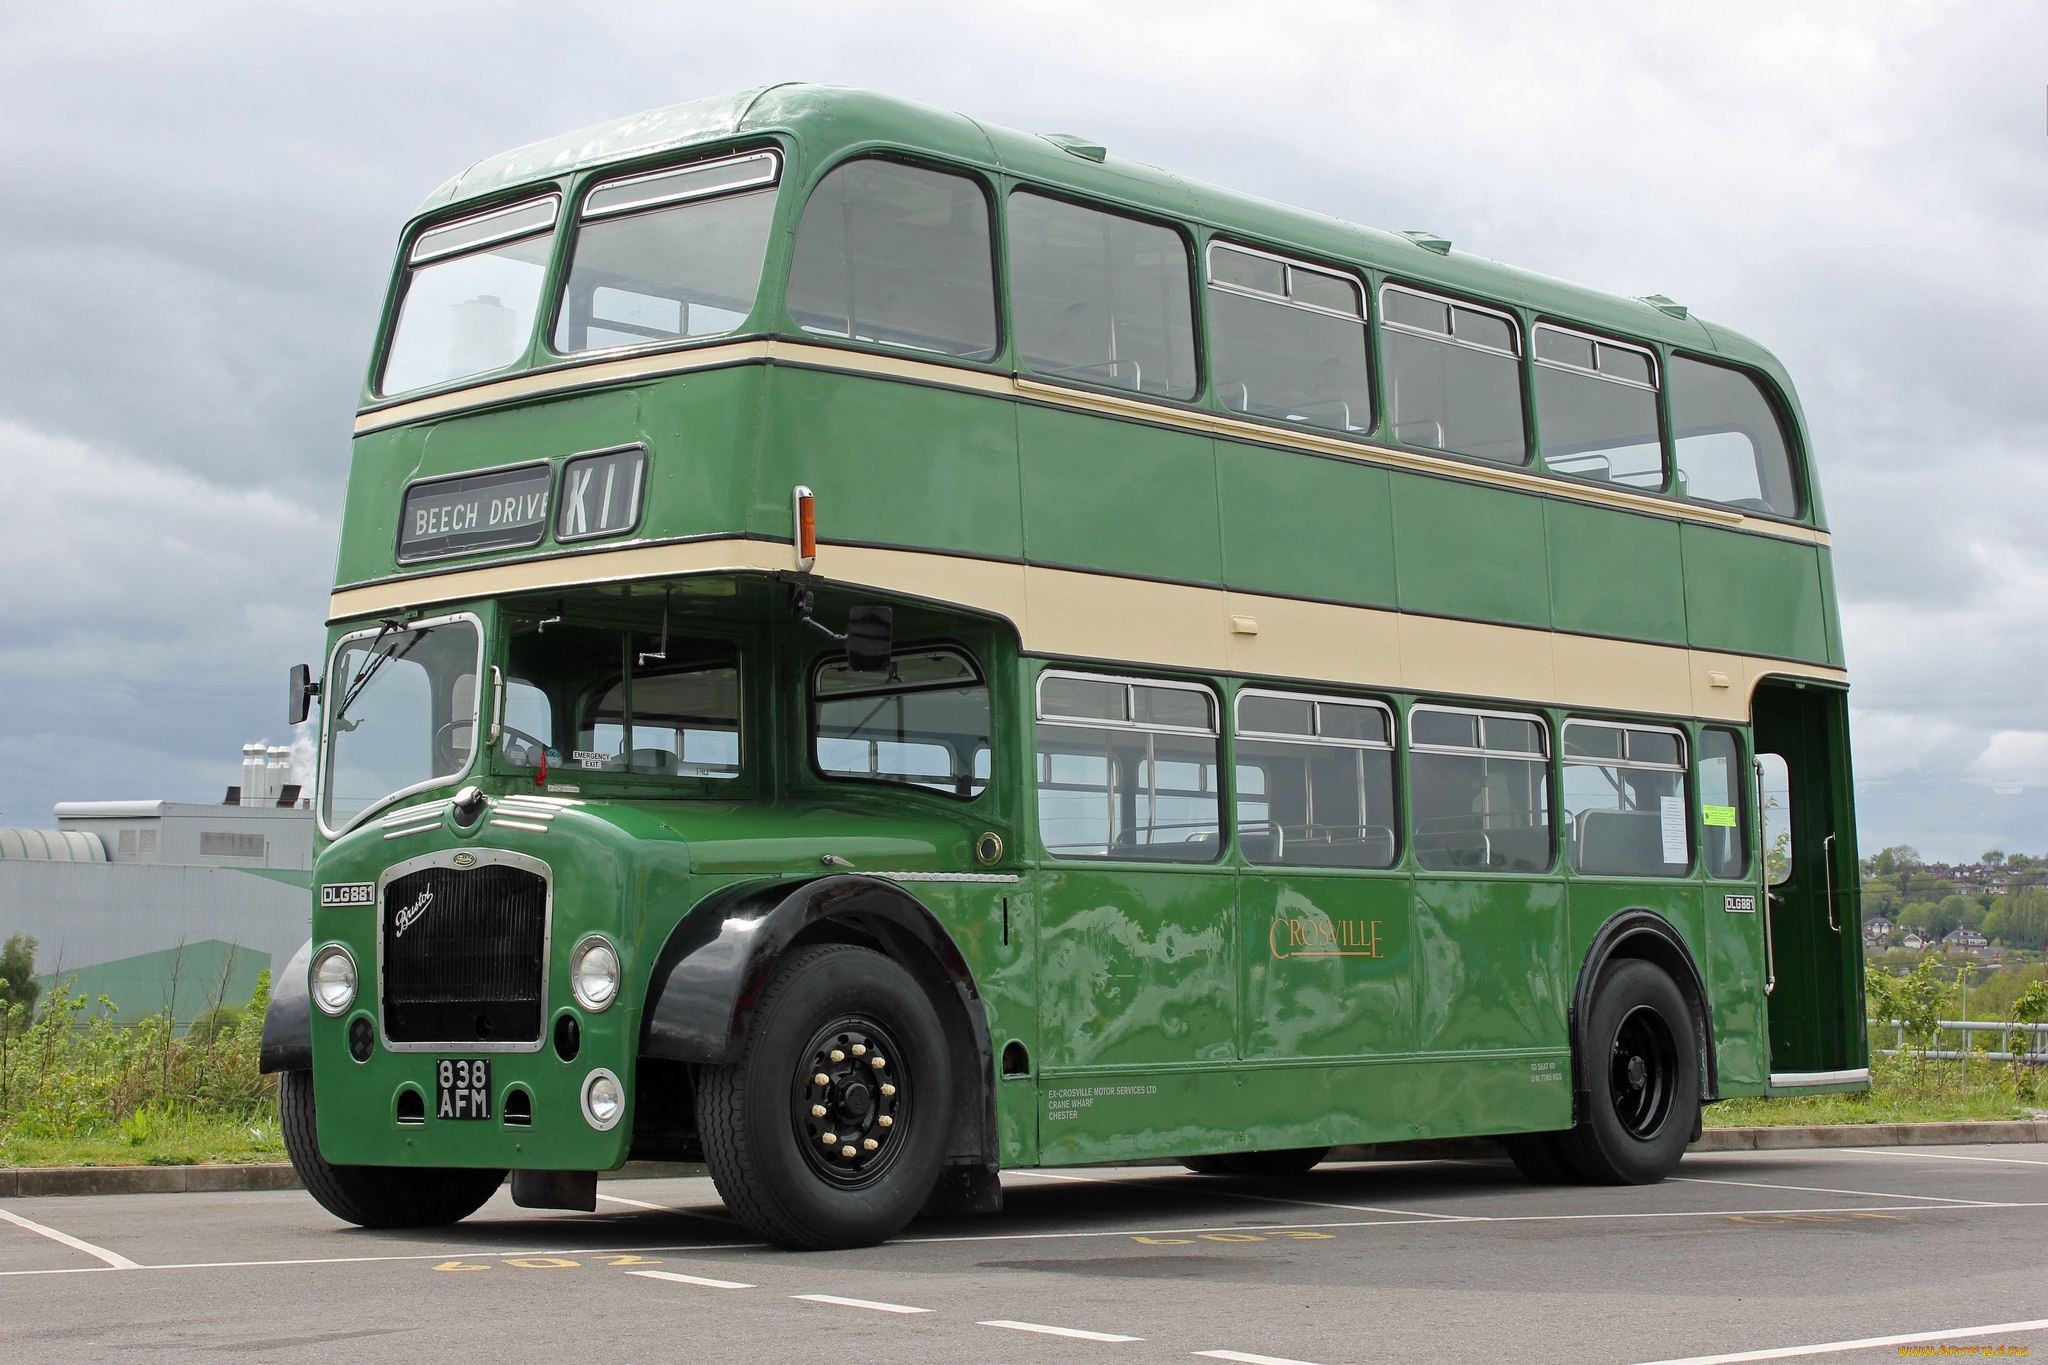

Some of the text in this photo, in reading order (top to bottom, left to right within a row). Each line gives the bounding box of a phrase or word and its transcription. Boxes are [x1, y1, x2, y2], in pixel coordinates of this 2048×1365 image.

[415, 491, 549, 536] BEECH DRIVE
[574, 751, 610, 761] EMERGENCY
[585, 760, 599, 768] EXIT
[323, 886, 373, 903] DLG881
[395, 882, 434, 938] Bristol
[1269, 918, 1384, 960] CROSVILLE
[440, 1060, 486, 1089] 838
[1048, 1085, 1157, 1098] EX-CROSVILLE MOTOR SERVICES LTD
[440, 1089, 487, 1118] AFM
[1048, 1098, 1094, 1109] CRANE WHARF
[1048, 1110, 1078, 1120] CHESTER
